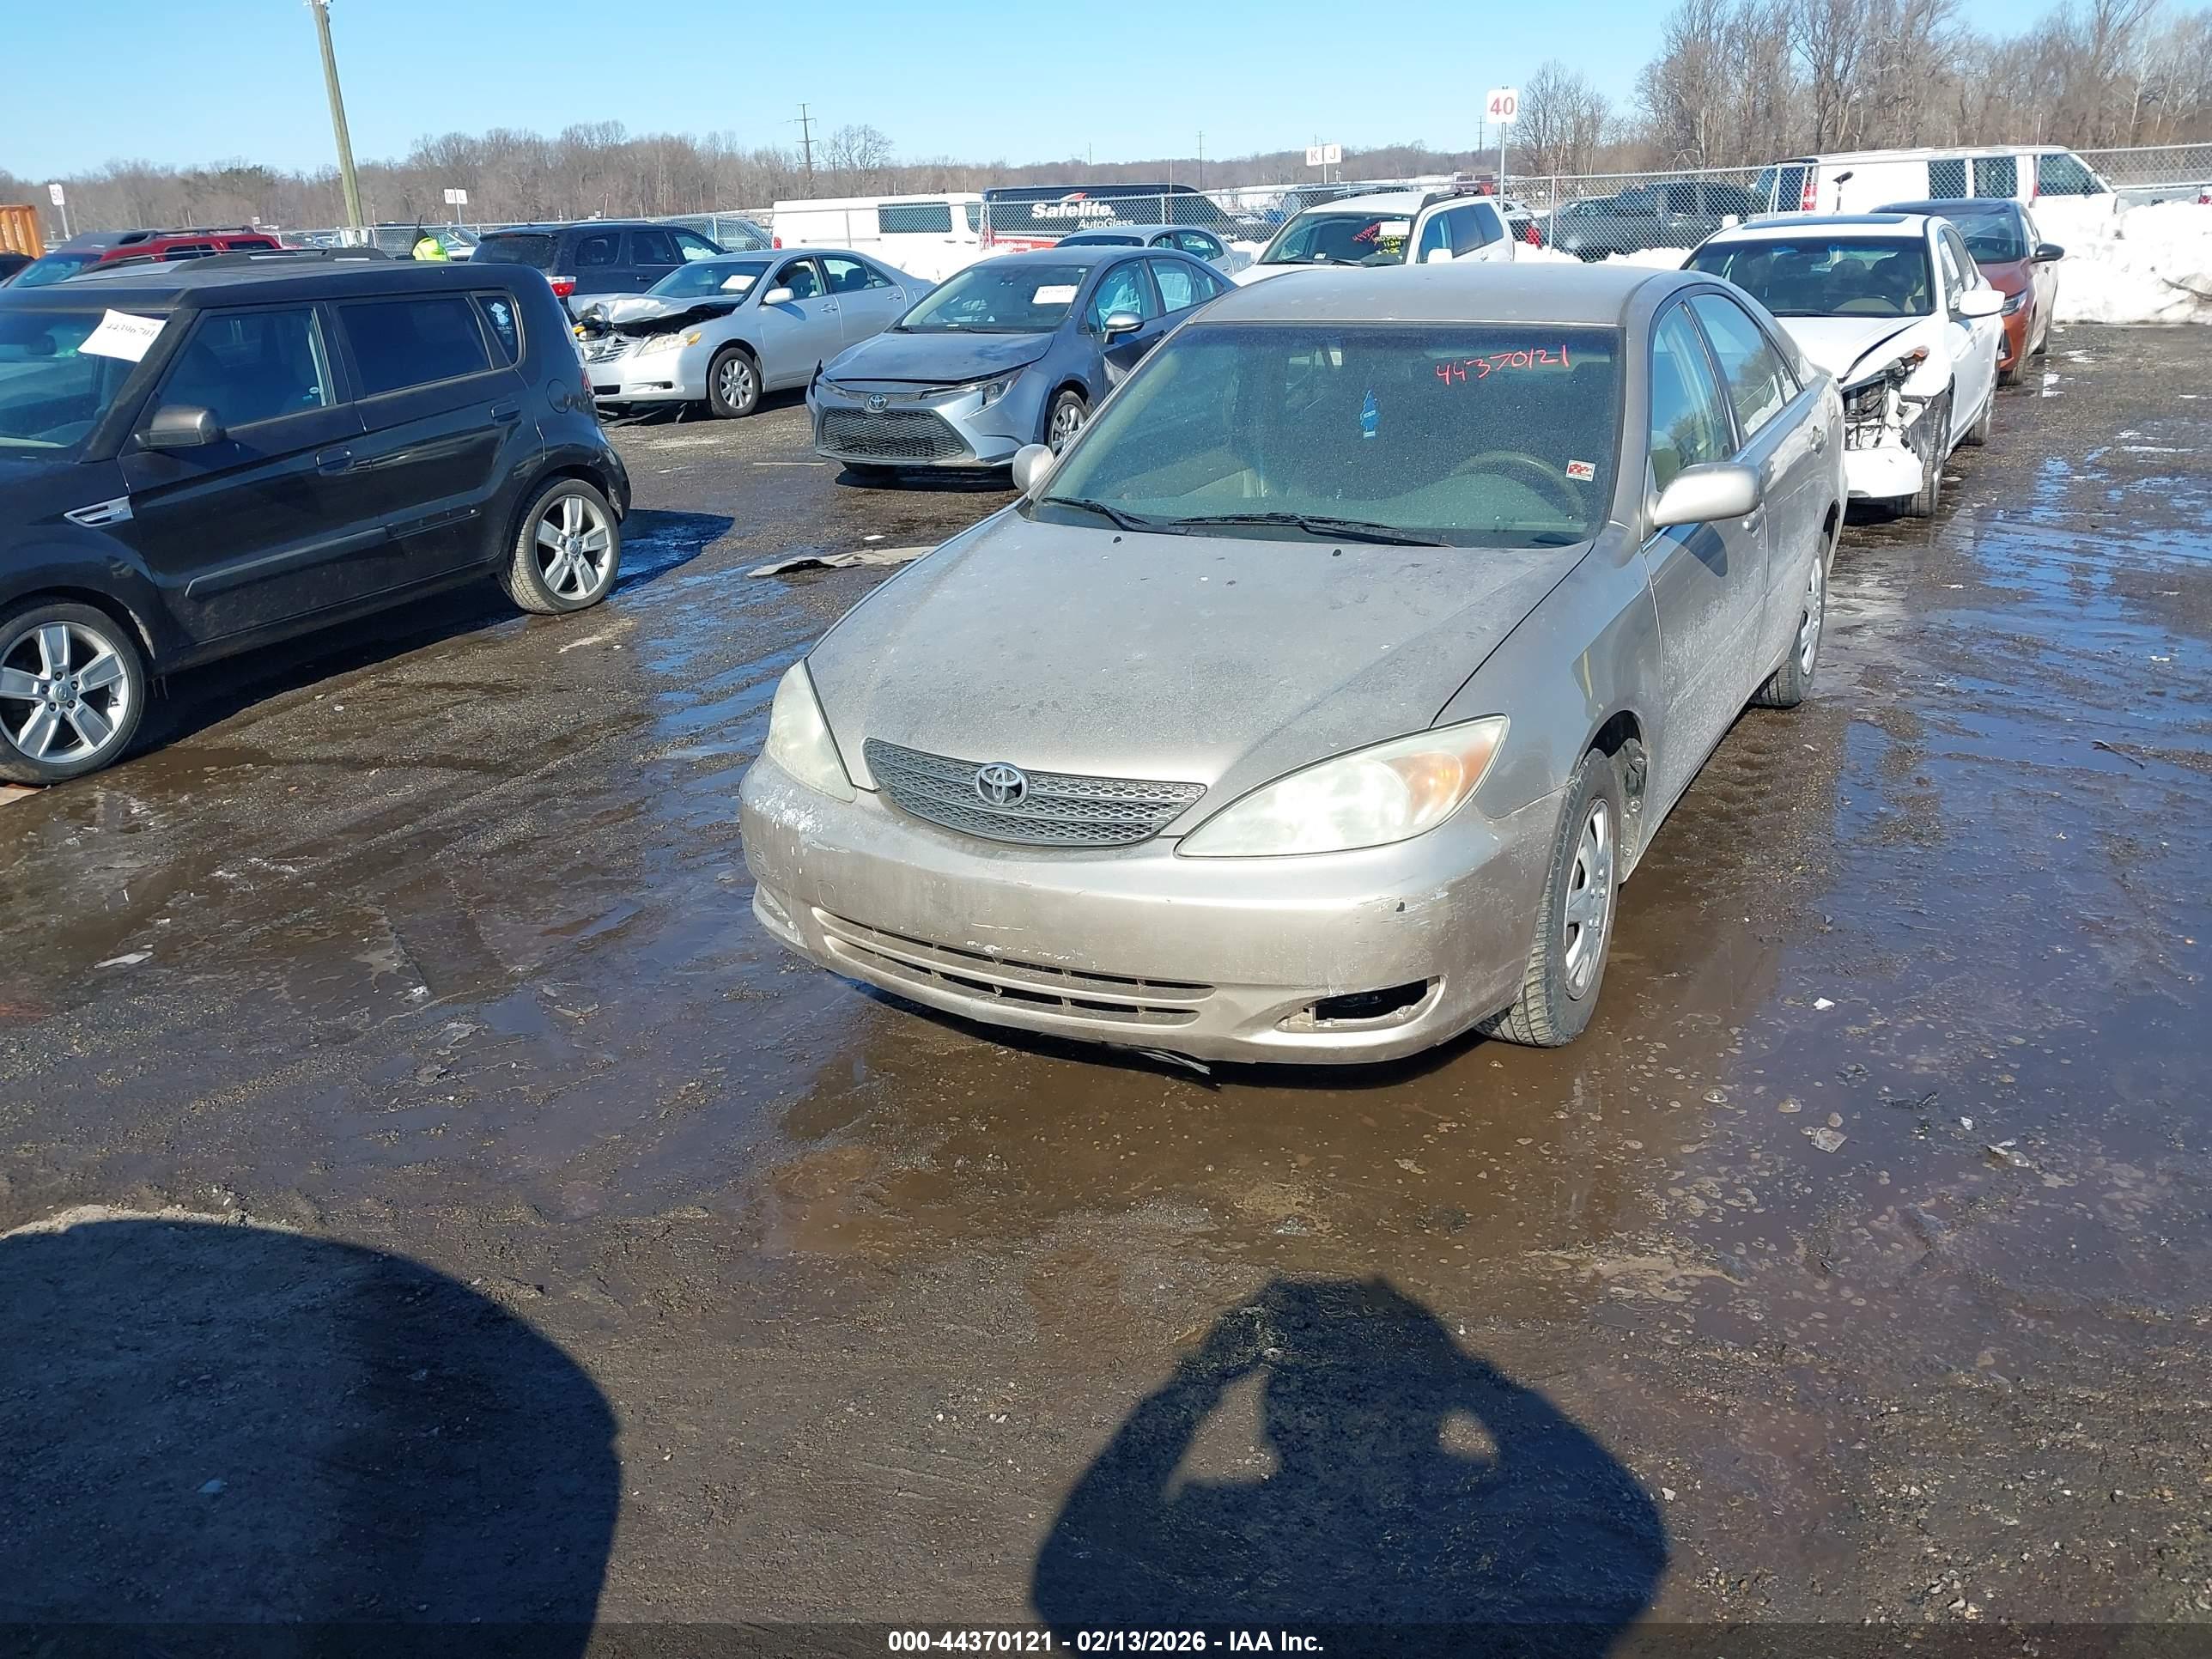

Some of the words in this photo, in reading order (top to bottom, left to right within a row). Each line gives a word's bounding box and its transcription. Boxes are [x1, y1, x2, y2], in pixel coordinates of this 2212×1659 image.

[1490, 96, 1515, 115] 40
[1310, 149, 1319, 161] K
[1329, 147, 1336, 160] J
[1077, 217, 1134, 230] AutoGlass
[1437, 345, 1569, 386] 44370121
